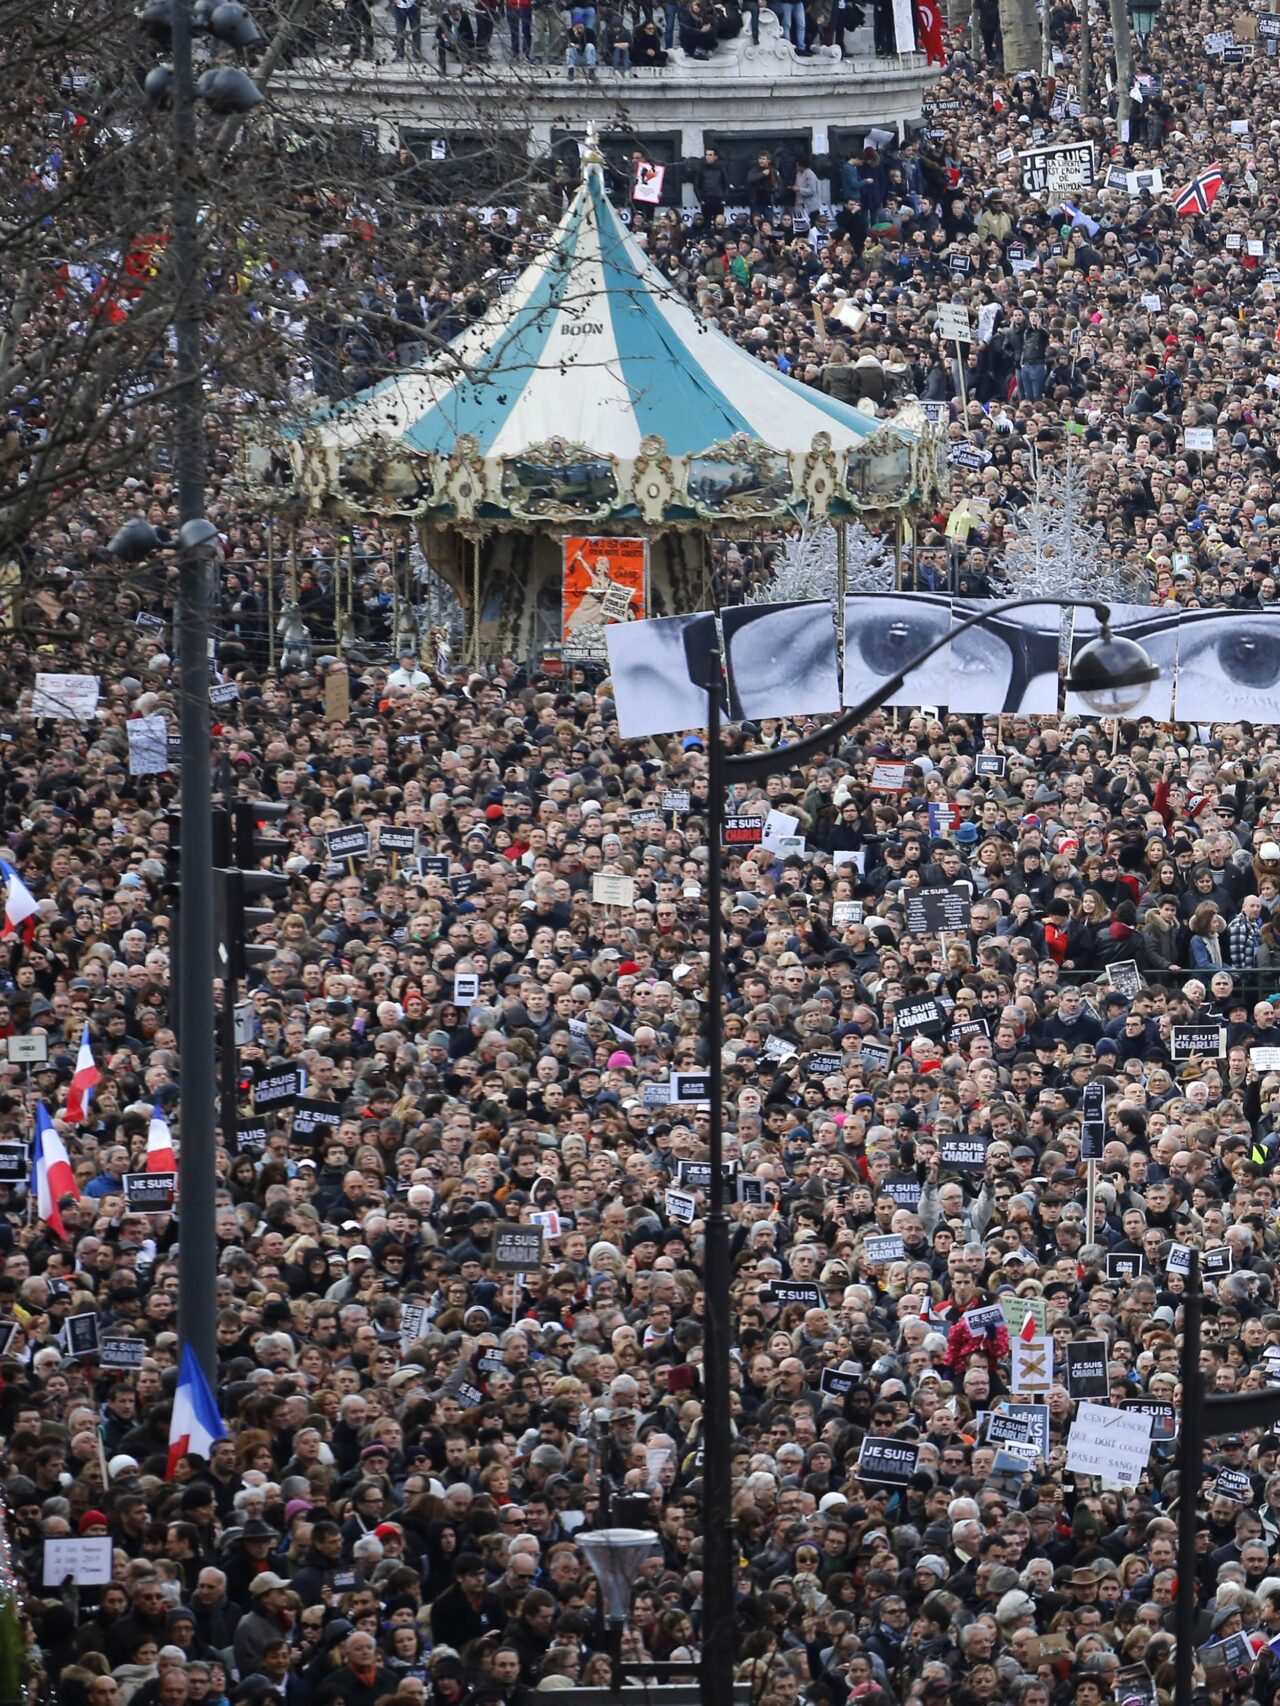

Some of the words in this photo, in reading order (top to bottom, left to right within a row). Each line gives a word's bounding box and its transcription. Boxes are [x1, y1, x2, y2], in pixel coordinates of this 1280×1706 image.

[1023, 156, 1045, 170] JE
[1054, 149, 1090, 166] SUIS
[1059, 174, 1069, 183] DE
[561, 322, 603, 337] BOON
[726, 819, 738, 829] JE
[739, 818, 763, 829] SUIS
[726, 828, 762, 841] CHARLIE
[331, 838, 366, 851] CHARLIE
[381, 839, 415, 849] CHARLIE
[899, 1007, 911, 1018] JE
[912, 1001, 937, 1014] SUIS
[899, 1008, 940, 1028] CHARLIE
[951, 1028, 962, 1037] JE
[962, 1024, 981, 1034] SUIS
[1191, 1033, 1220, 1041] SUIS
[1175, 1040, 1220, 1049] CHARLIE
[257, 1080, 268, 1090] JE
[268, 1072, 298, 1086] SUIS
[257, 1083, 299, 1103] CHARLIE
[296, 1110, 311, 1122] JE
[312, 1112, 342, 1125] SUIS
[238, 1128, 268, 1141] SUIS
[943, 1142, 957, 1151] JE
[958, 1142, 985, 1152] SUIS
[942, 1150, 986, 1163] CHARLIE
[131, 1180, 146, 1190] JE
[147, 1179, 174, 1189] SUIS
[883, 1184, 896, 1192] JE
[896, 1184, 921, 1193] SUIS
[499, 1235, 512, 1245] JE
[513, 1235, 540, 1246] SUIS
[868, 1243, 880, 1251] JE
[881, 1240, 904, 1249] SUIS
[498, 1246, 540, 1261] CHARLIE
[868, 1247, 905, 1261] CHARLIE
[106, 1341, 117, 1351] JE
[119, 1342, 145, 1352] SUIS
[105, 1350, 145, 1361] CHARLIE
[1072, 1362, 1083, 1370] JE
[1084, 1361, 1103, 1369] SUIS
[1072, 1369, 1104, 1378] CHARLIE
[1013, 1411, 1045, 1422] MÊME
[1126, 1406, 1141, 1414] JE
[1142, 1406, 1173, 1416] SUIS
[993, 1419, 1005, 1429] JE
[1005, 1421, 1028, 1433] SUIS
[992, 1427, 1029, 1441] CHARLIE
[1070, 1431, 1086, 1441] QUI
[1095, 1437, 1116, 1448] DOIT
[1119, 1443, 1149, 1455] COULER
[865, 1445, 881, 1457] JE
[882, 1448, 915, 1461] SUIS
[864, 1455, 916, 1475] CHARLIE
[1071, 1451, 1088, 1461] PAS
[1090, 1455, 1101, 1465] LE
[1108, 1459, 1132, 1470] SANG
